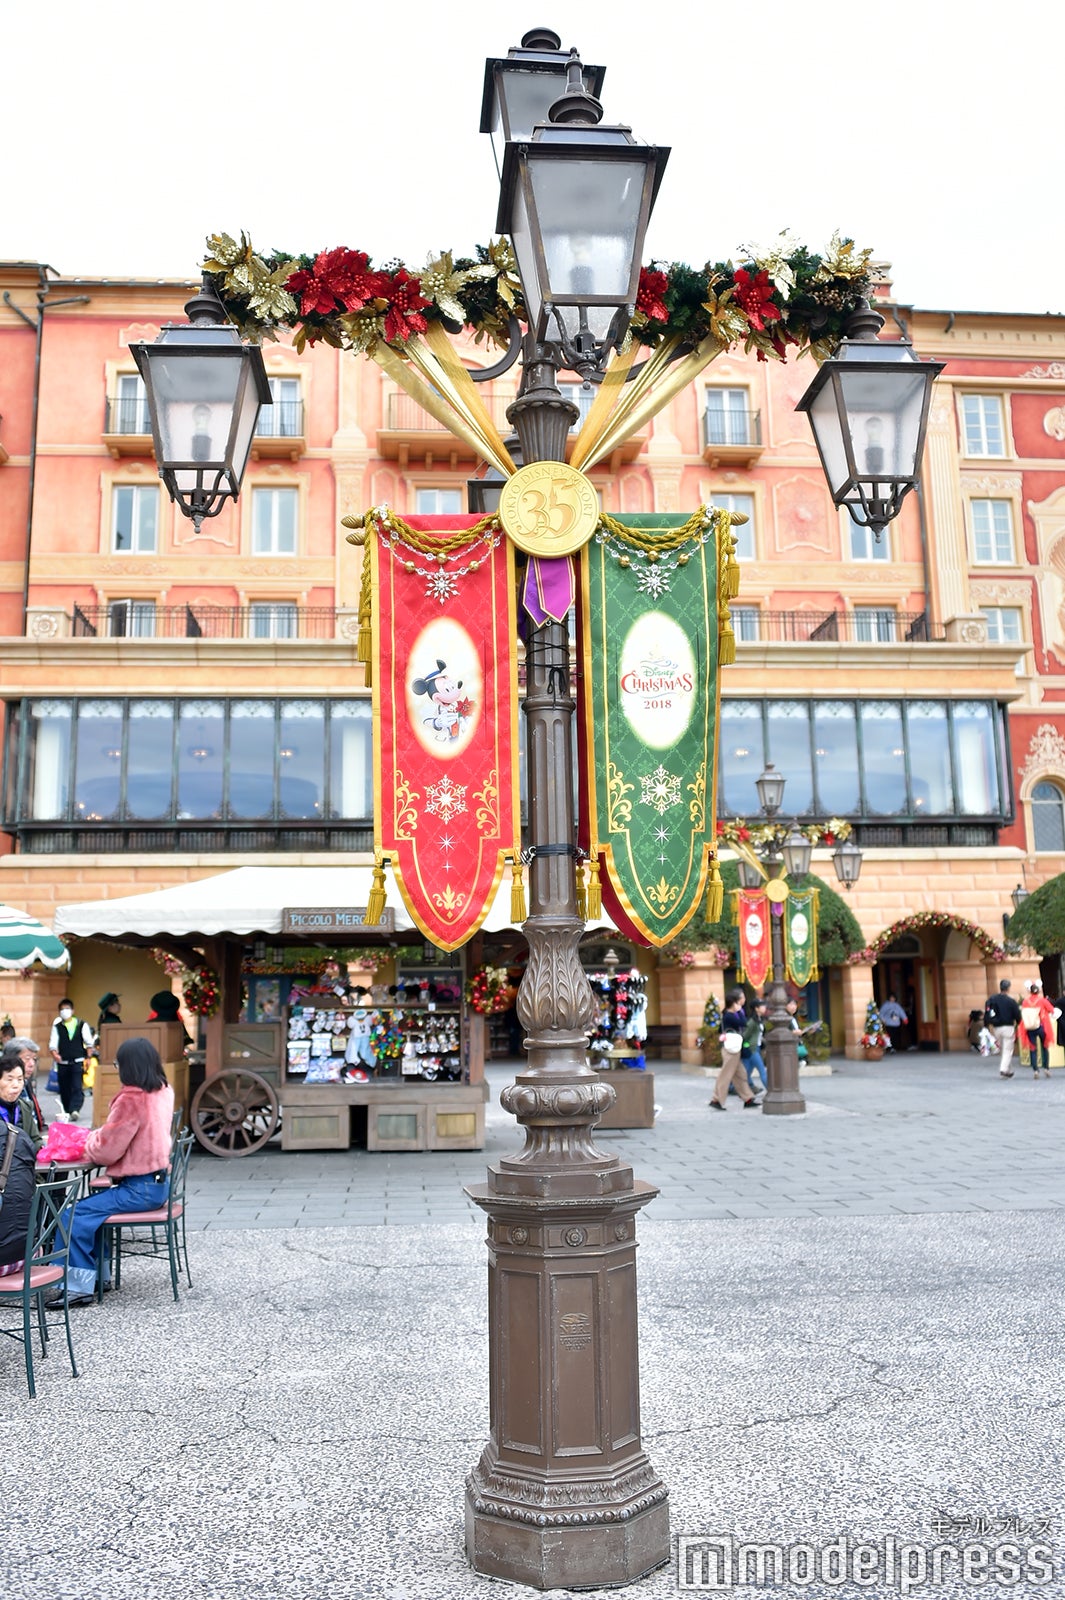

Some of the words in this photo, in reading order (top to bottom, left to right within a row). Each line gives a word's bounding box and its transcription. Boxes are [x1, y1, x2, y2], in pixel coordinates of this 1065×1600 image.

[506, 484, 521, 527] TOKYO
[520, 467, 568, 485] DISNEY
[568, 474, 593, 519] RESORT
[518, 478, 577, 540] 35
[641, 665, 675, 678] Disney
[621, 670, 693, 694] CHRISTMAS
[644, 700, 672, 709] 2018
[289, 913, 332, 926] PICCOLO
